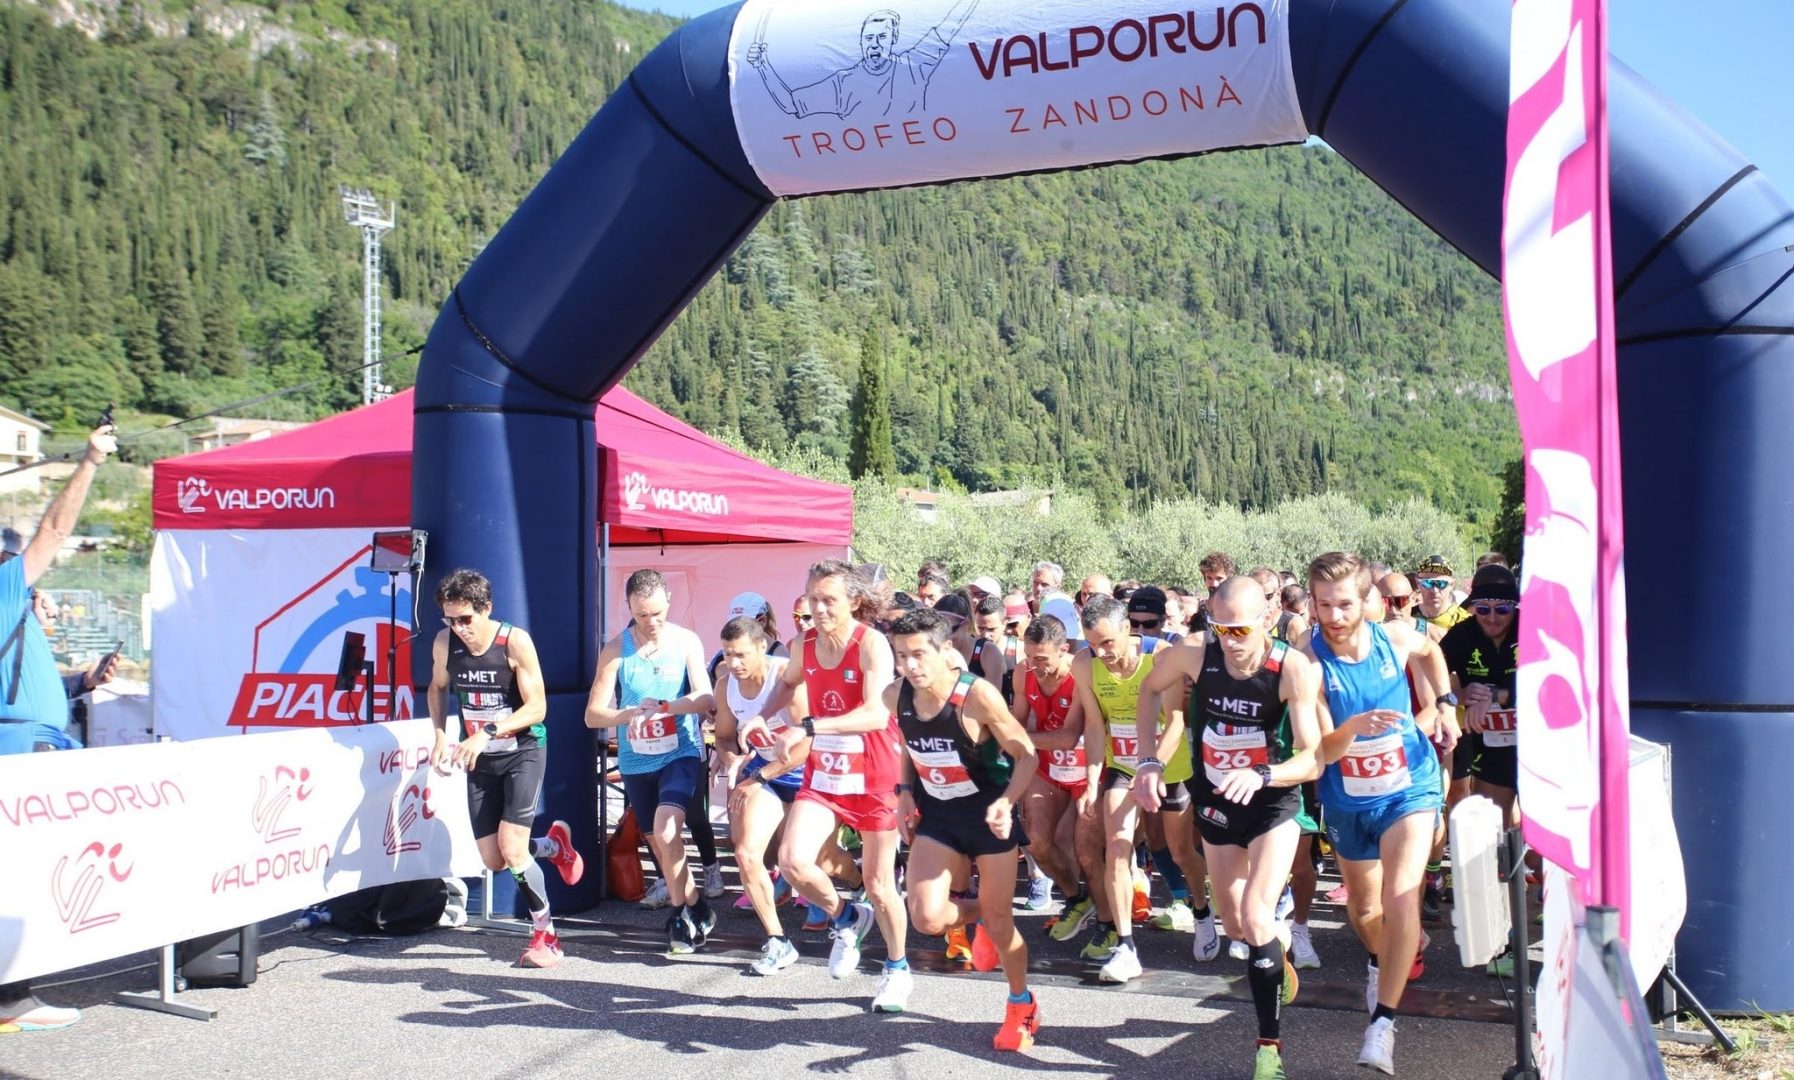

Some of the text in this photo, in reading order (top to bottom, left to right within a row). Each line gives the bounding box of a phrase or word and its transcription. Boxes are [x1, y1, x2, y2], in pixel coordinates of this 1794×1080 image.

[968, 2, 1267, 81] VALPORUN
[783, 75, 1242, 158] TROFEO ZANDONÀ
[214, 487, 335, 510] VALPORUN
[650, 487, 729, 515] VALPORUN
[468, 670, 497, 683] MET
[1222, 696, 1262, 717] MET
[919, 737, 955, 752] MET
[820, 752, 851, 774] 94
[1052, 749, 1078, 766] 95
[1213, 750, 1251, 769] 26
[1346, 751, 1401, 777] 193
[929, 768, 946, 785] 6
[0, 779, 185, 826] VALPORUN
[211, 843, 331, 894] VALPORUN
